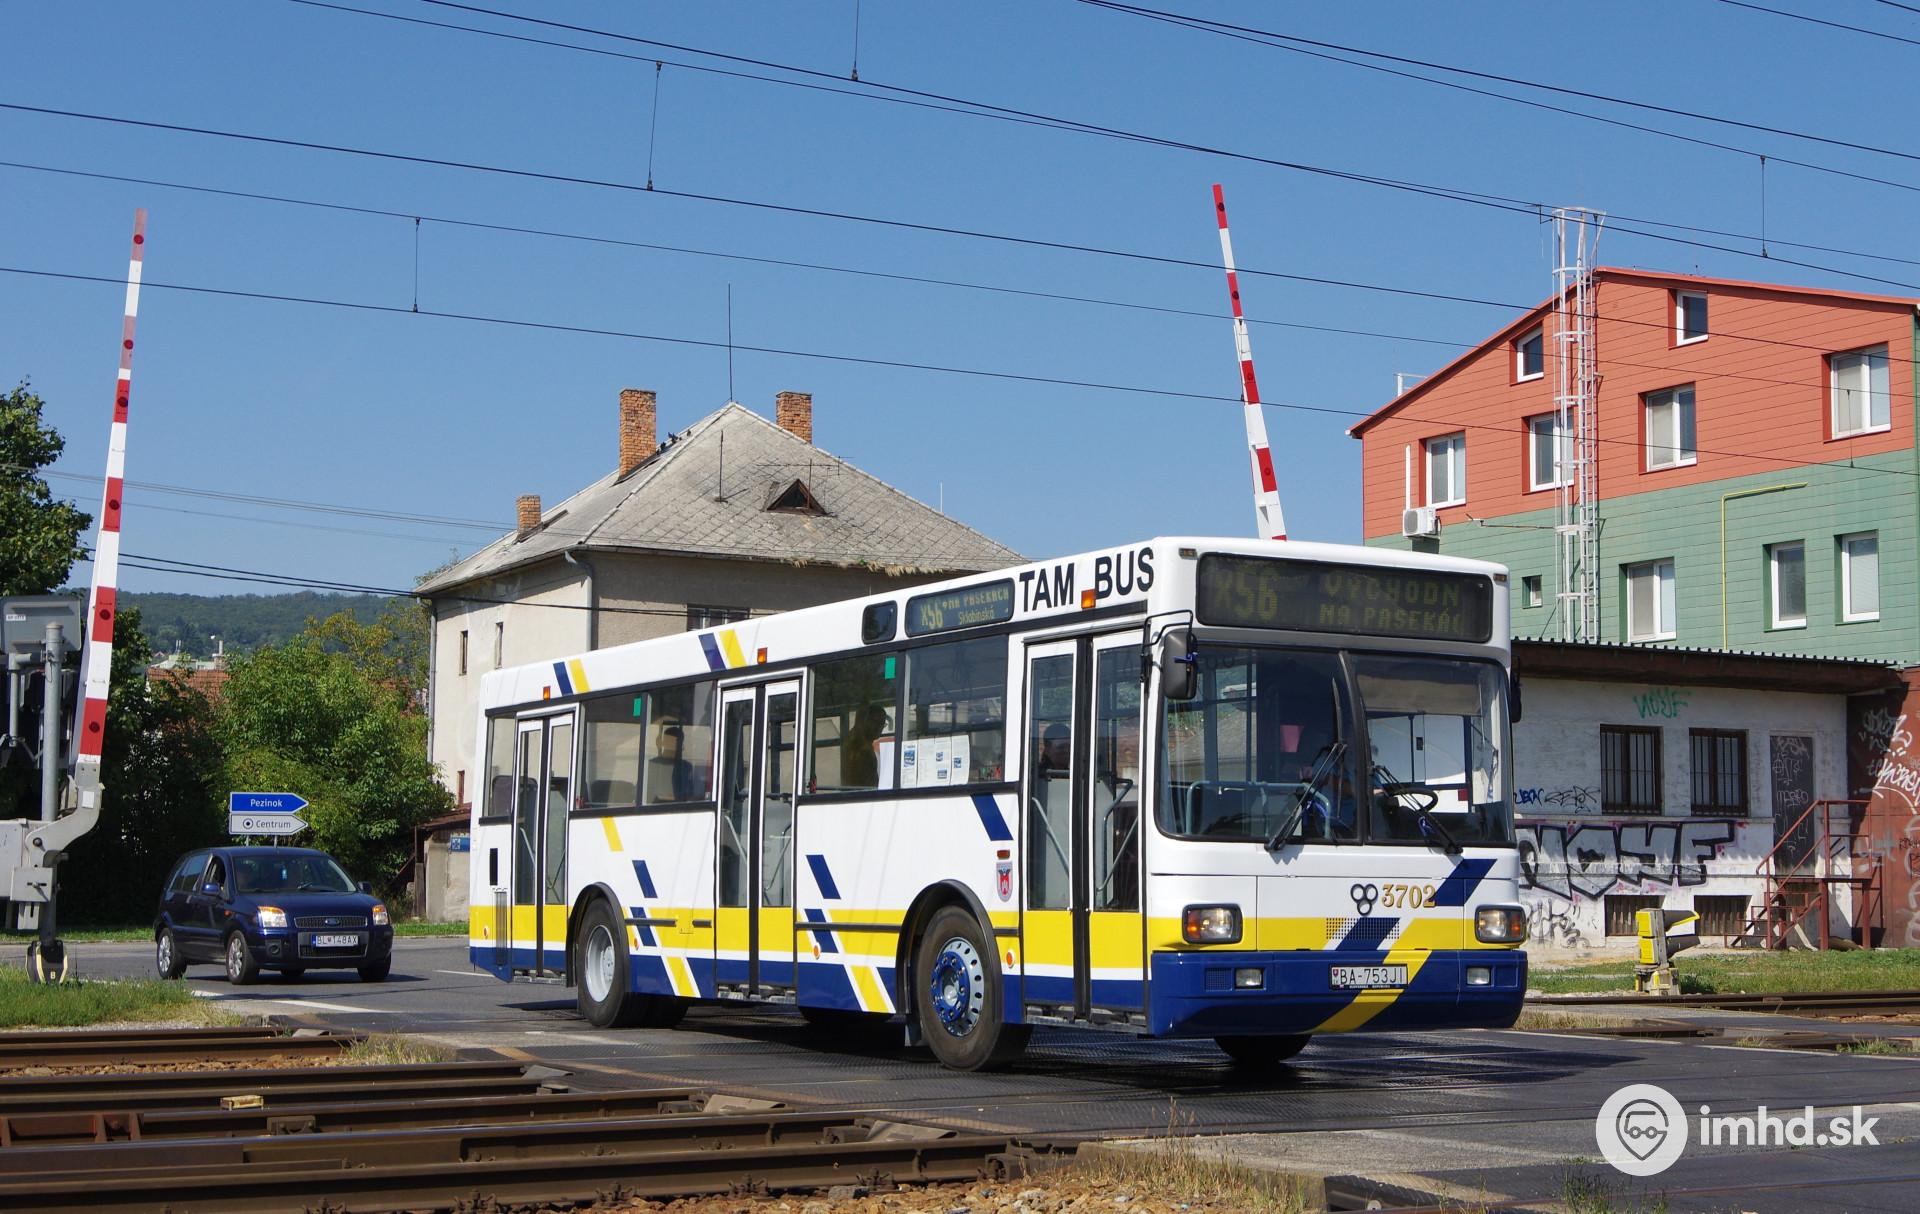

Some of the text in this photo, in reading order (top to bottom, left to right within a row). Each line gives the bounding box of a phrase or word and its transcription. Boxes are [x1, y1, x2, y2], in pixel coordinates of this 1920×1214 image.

[1019, 547, 1153, 612] TAM BUS
[1214, 565, 1279, 621] X56
[921, 597, 944, 630] X56
[250, 798, 283, 807] Pezinok
[256, 820, 291, 828] Centrum
[1381, 884, 1436, 908] 3702
[1340, 967, 1403, 985] BA-753JI
